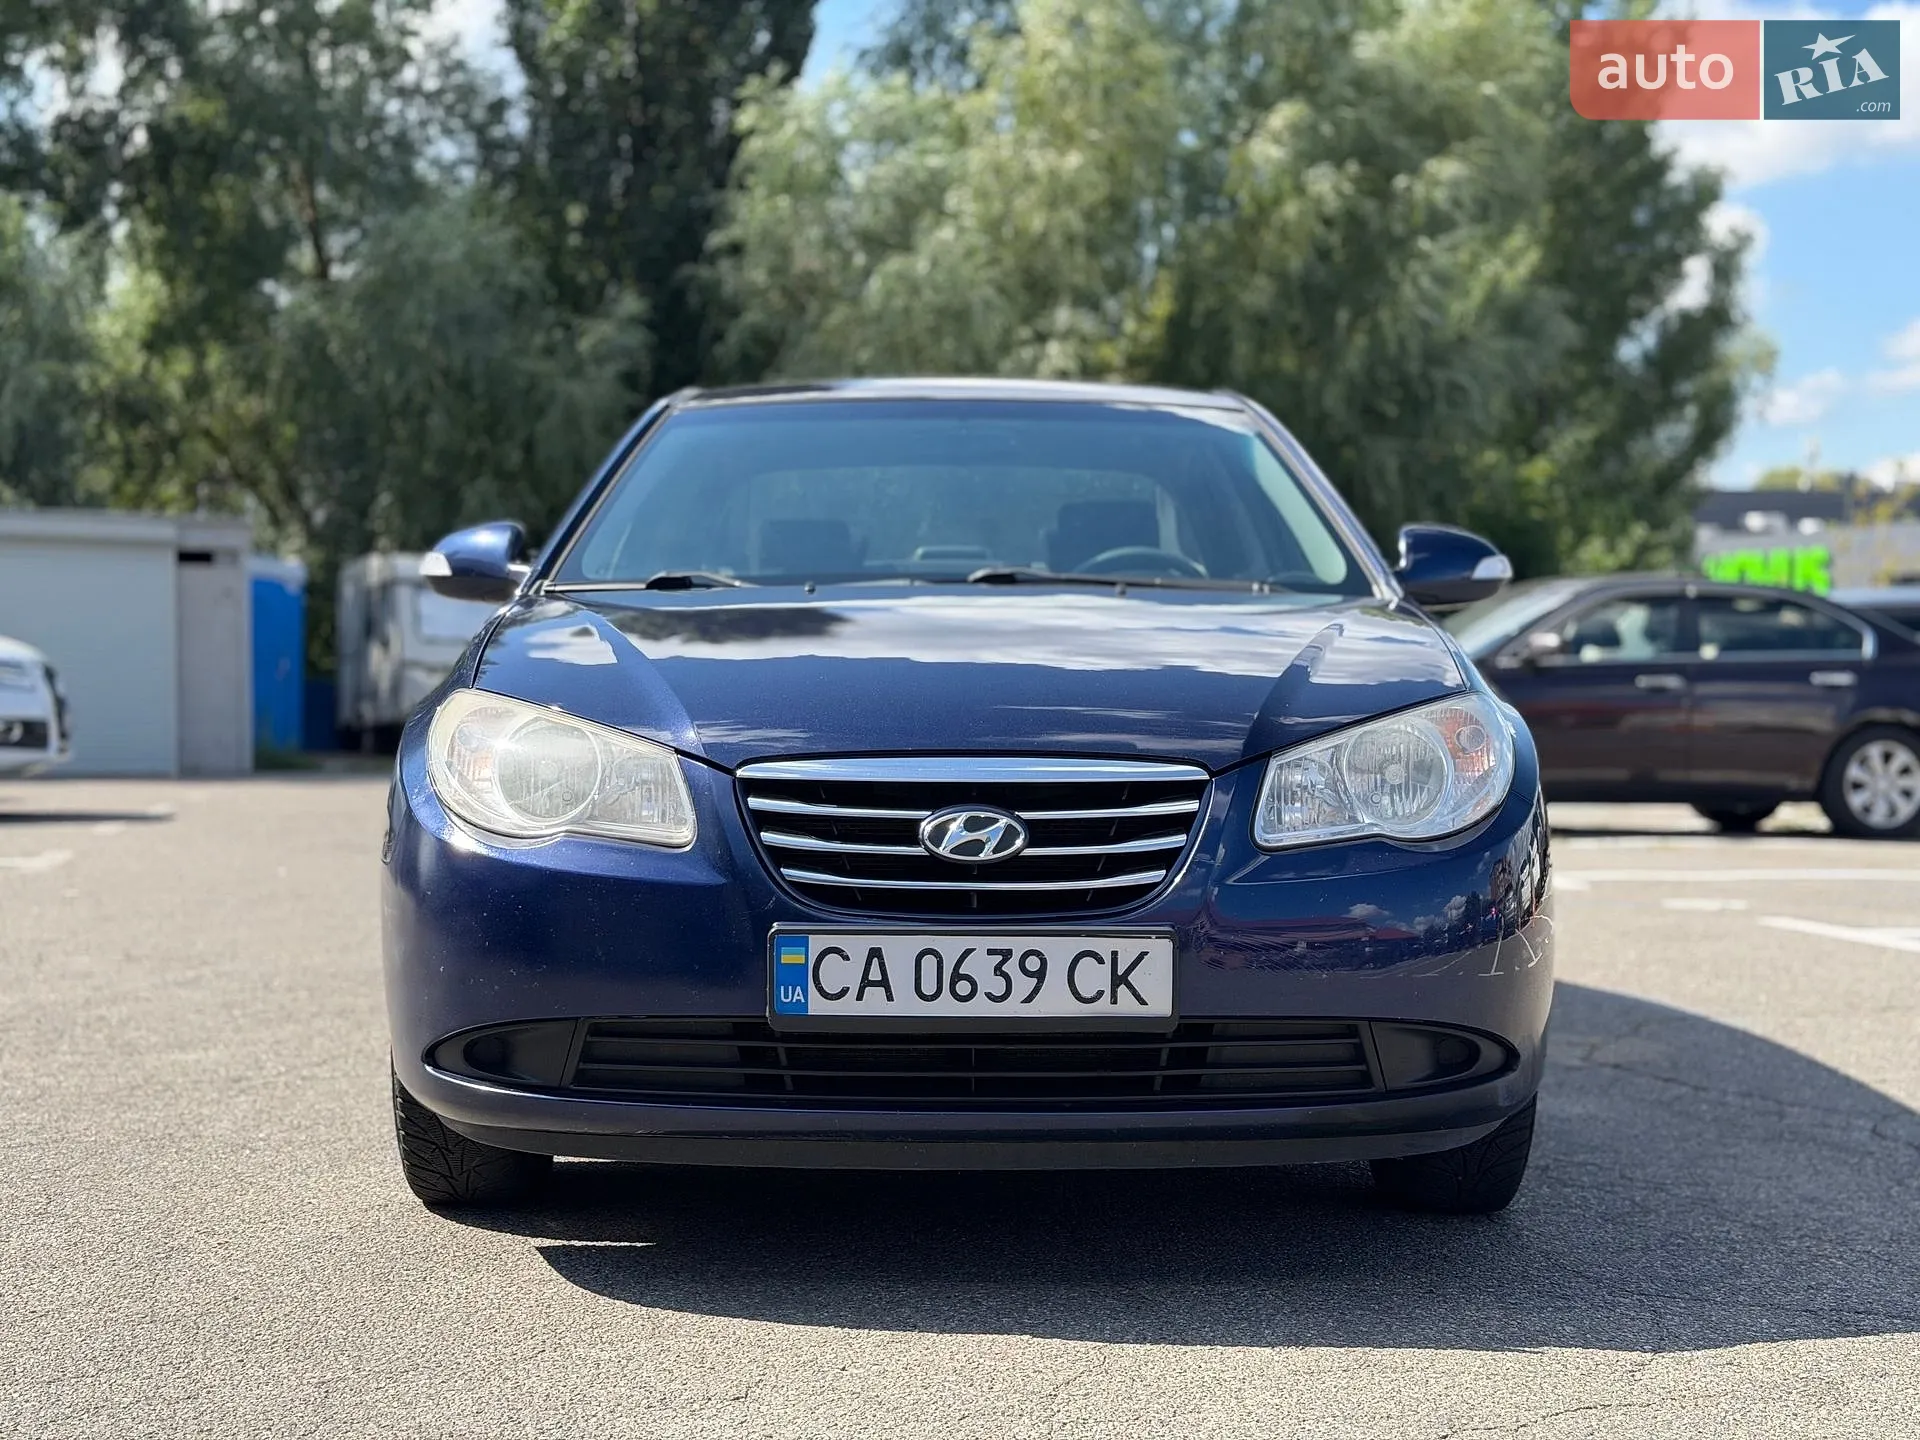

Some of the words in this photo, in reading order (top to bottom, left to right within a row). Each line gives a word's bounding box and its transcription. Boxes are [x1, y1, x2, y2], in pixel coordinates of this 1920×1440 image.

[780, 986, 805, 1003] UA
[811, 946, 895, 1002] CA
[913, 947, 1048, 1005] 0639
[1067, 949, 1150, 1006] CK
